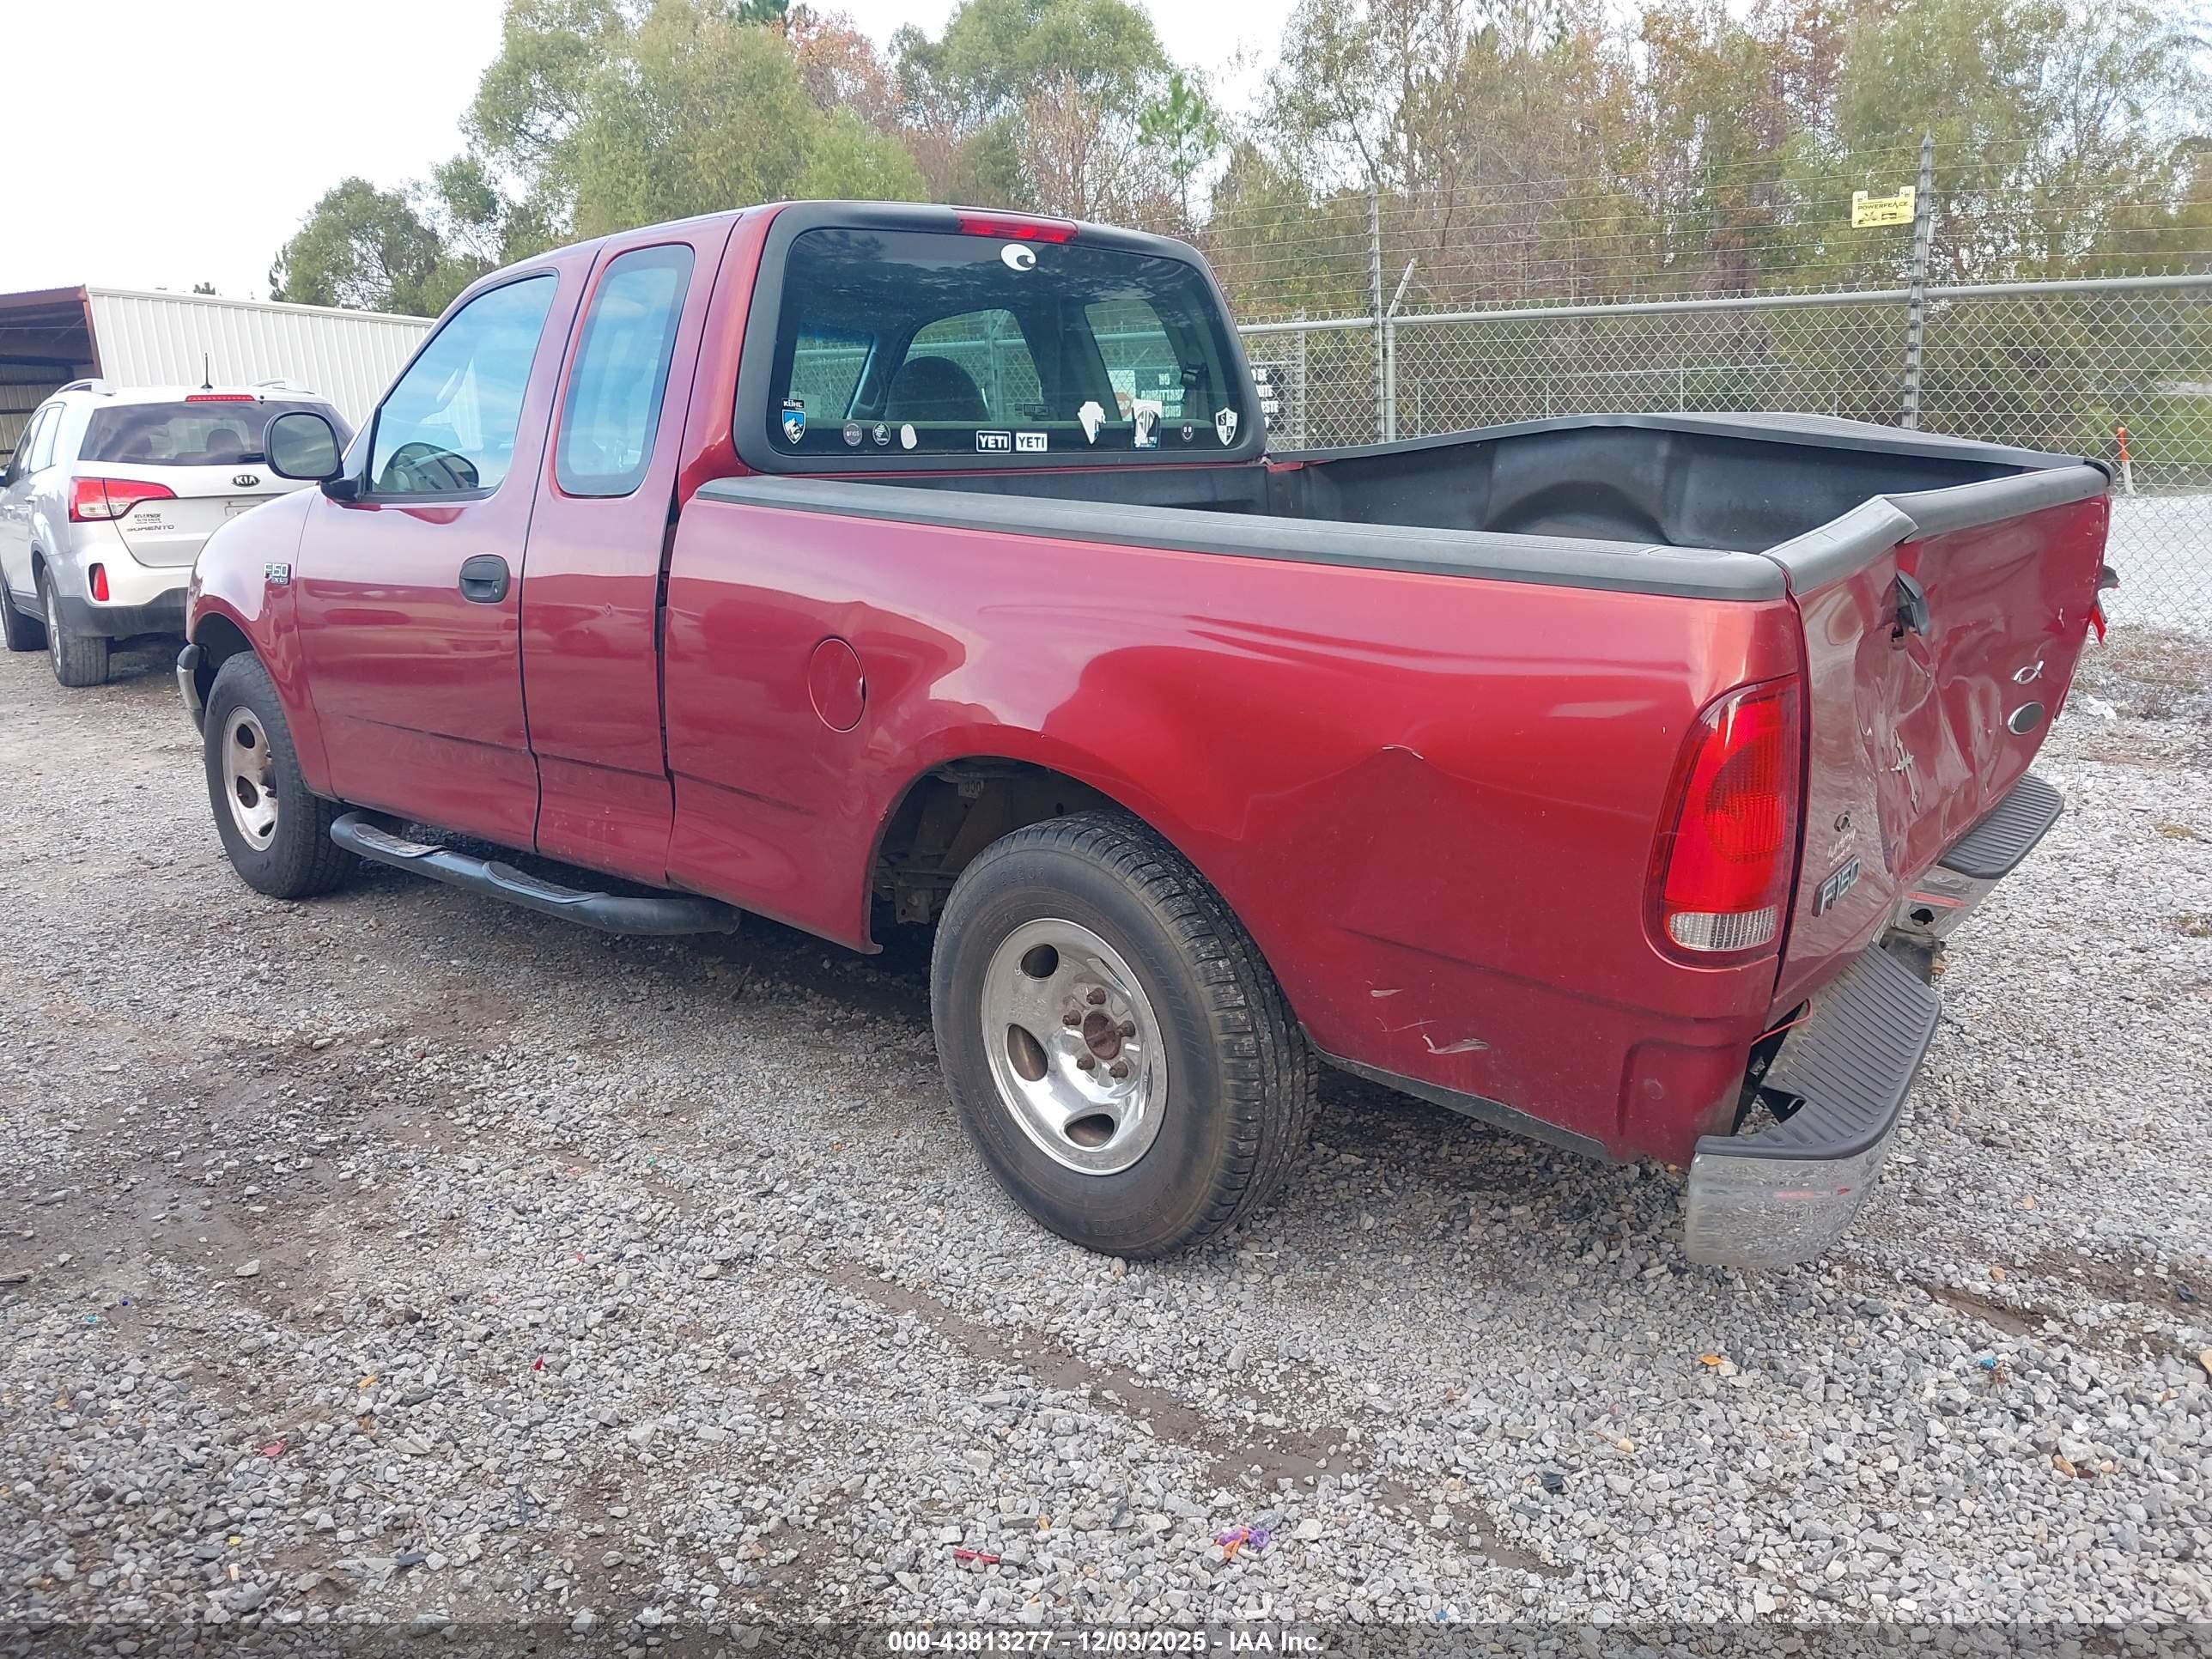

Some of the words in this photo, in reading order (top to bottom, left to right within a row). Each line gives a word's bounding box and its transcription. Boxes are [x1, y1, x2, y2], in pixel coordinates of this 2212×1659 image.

[1158, 373, 1170, 386] NO
[979, 434, 1008, 448] YETI
[1018, 436, 1045, 448] YETI
[236, 476, 258, 485] KIA
[1820, 857, 1861, 915] F150
